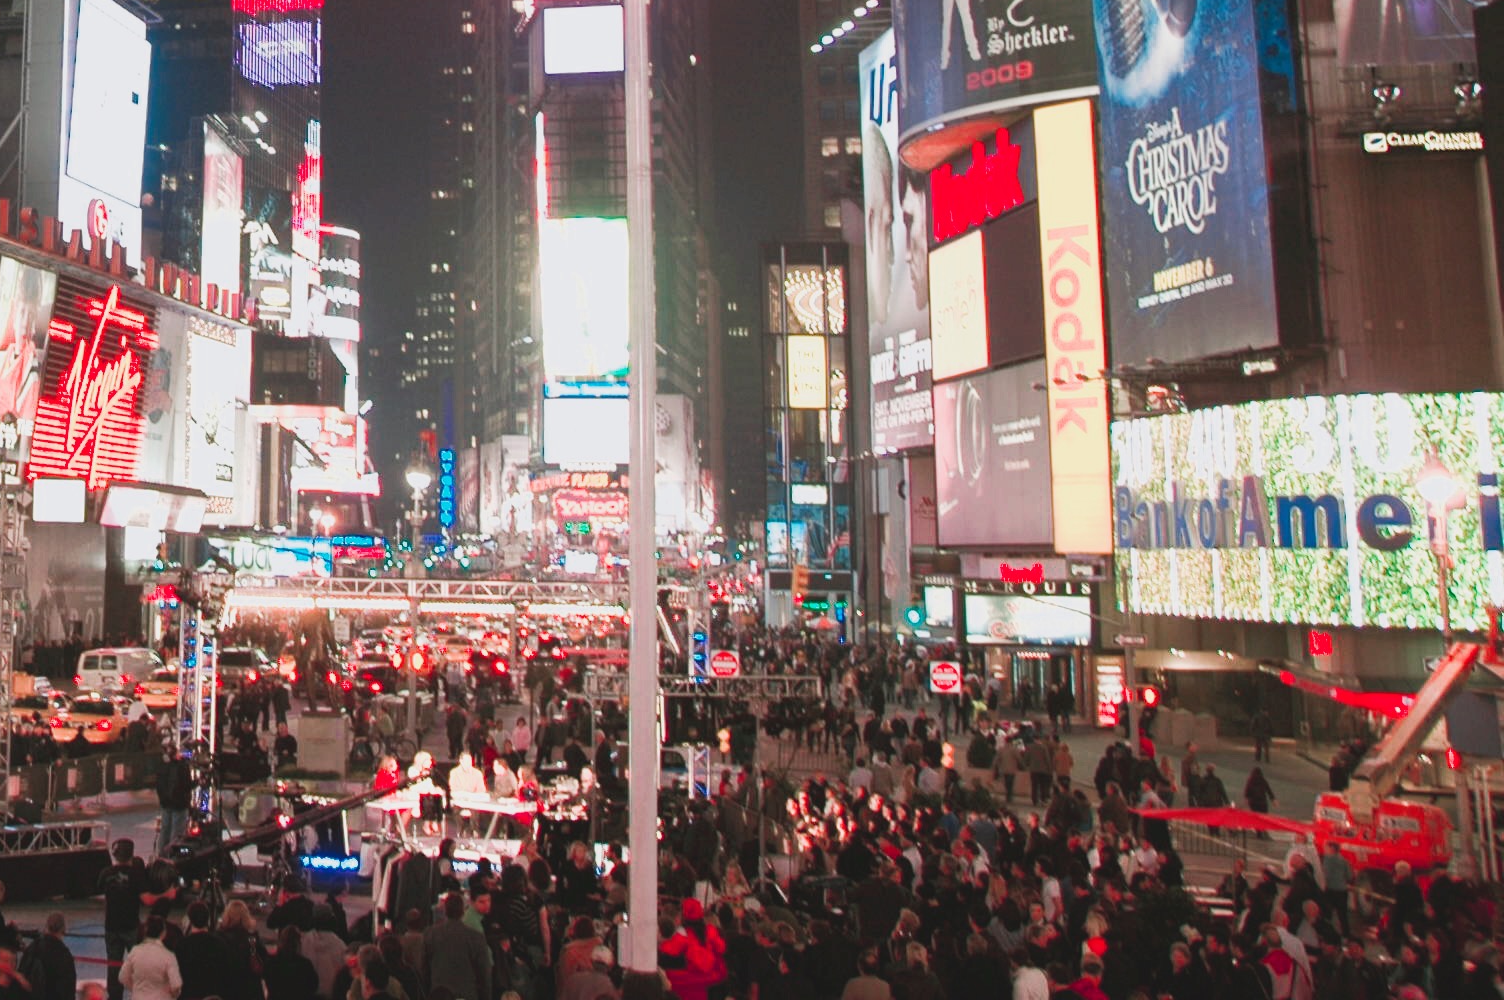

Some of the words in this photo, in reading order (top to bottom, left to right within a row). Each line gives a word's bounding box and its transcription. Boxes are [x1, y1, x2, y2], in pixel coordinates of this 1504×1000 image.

[987, 24, 1069, 56] Sheckler
[966, 61, 1034, 91] 2009
[1171, 107, 1183, 138] A
[1125, 120, 1229, 205] CHRISTMAS
[1147, 171, 1217, 235] CAROL
[1154, 259, 1205, 292] NOVEMBER
[1047, 224, 1098, 435] Kodak
[557, 498, 625, 516] YAHOO!
[1116, 481, 1192, 549] Bank
[1198, 479, 1232, 549] of
[1239, 475, 1504, 550] Amei
[964, 581, 1092, 595] MARQUIS
